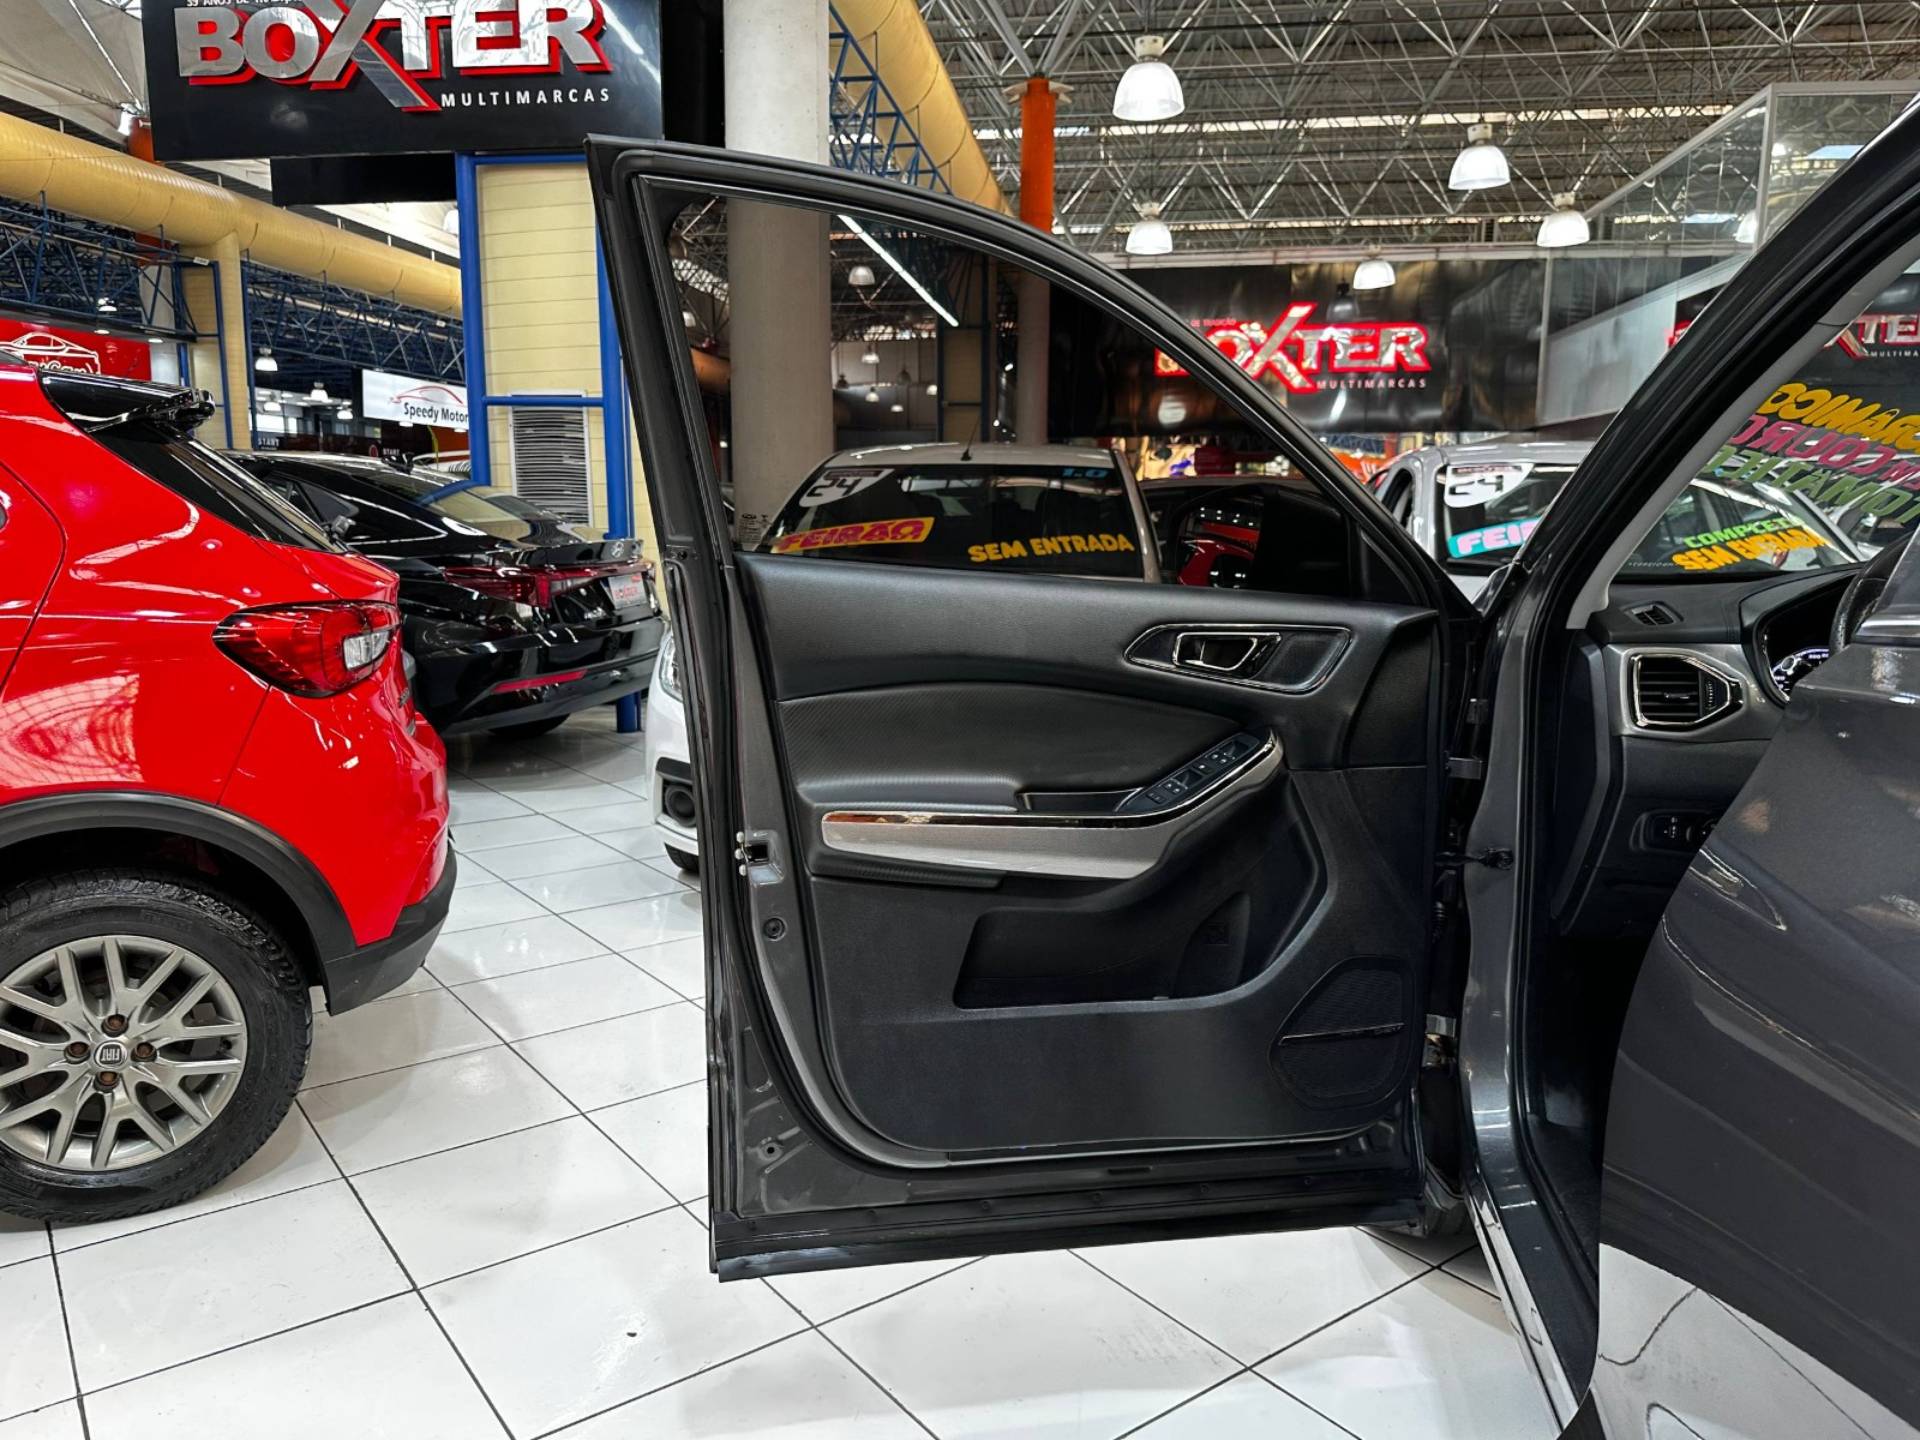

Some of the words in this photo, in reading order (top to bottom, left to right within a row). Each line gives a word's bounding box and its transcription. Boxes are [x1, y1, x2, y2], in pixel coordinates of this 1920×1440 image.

[174, 0, 613, 112] BOXTER
[441, 87, 610, 108] MULTIMARCAS
[1317, 378, 1427, 390] MULTIMARCAS
[404, 402, 439, 422] Speedy
[806, 477, 863, 498] 24
[968, 544, 1027, 563] SEM
[1030, 533, 1135, 558] ENTRADA
[1672, 544, 1741, 571] SEM
